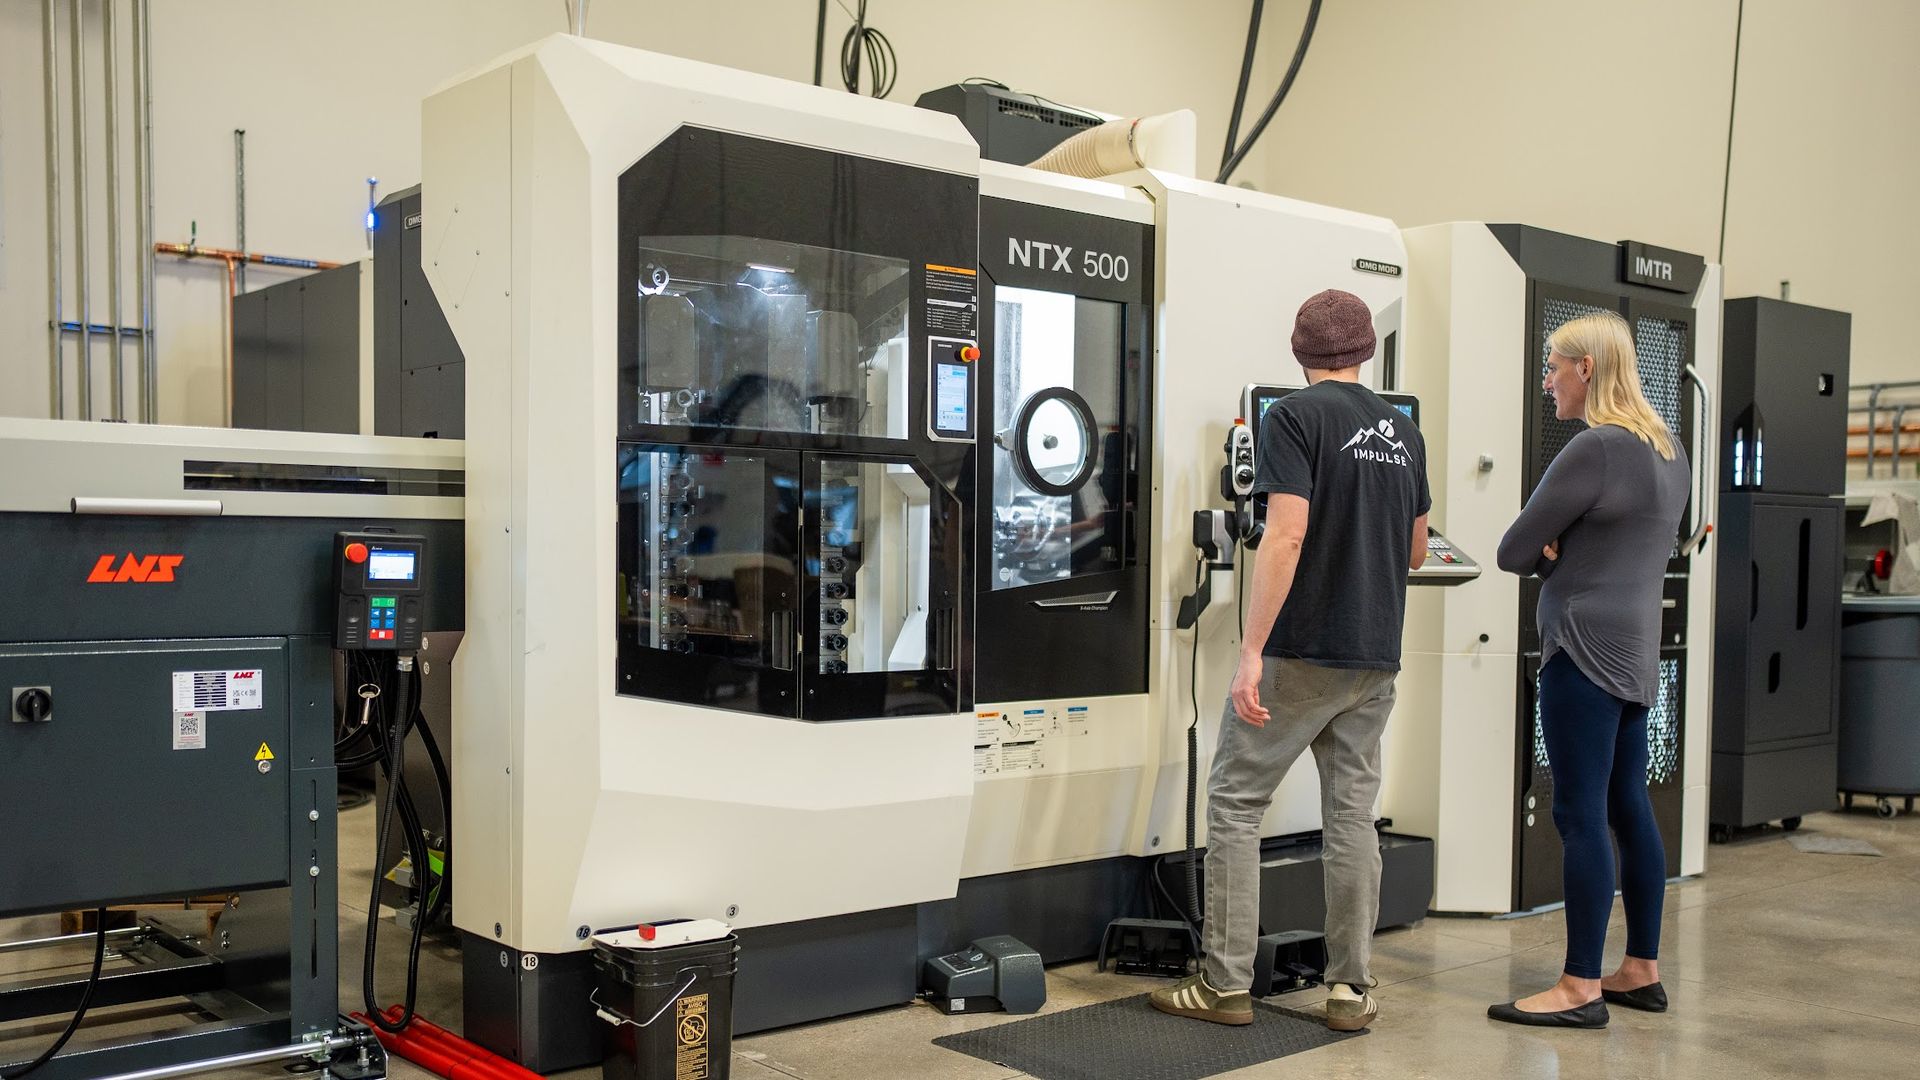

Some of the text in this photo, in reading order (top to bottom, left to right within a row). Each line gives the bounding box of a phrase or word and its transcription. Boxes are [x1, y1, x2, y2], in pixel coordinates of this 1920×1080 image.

[1008, 237, 1129, 282] NTX 500
[1359, 260, 1398, 275] DMG MORI
[1635, 256, 1672, 281] IMTR
[1353, 448, 1407, 467] IMPULSE
[86, 551, 184, 583] LNS
[233, 671, 254, 679] LNS
[729, 906, 736, 916] 3
[579, 927, 591, 938] 18
[524, 956, 536, 967] 18
